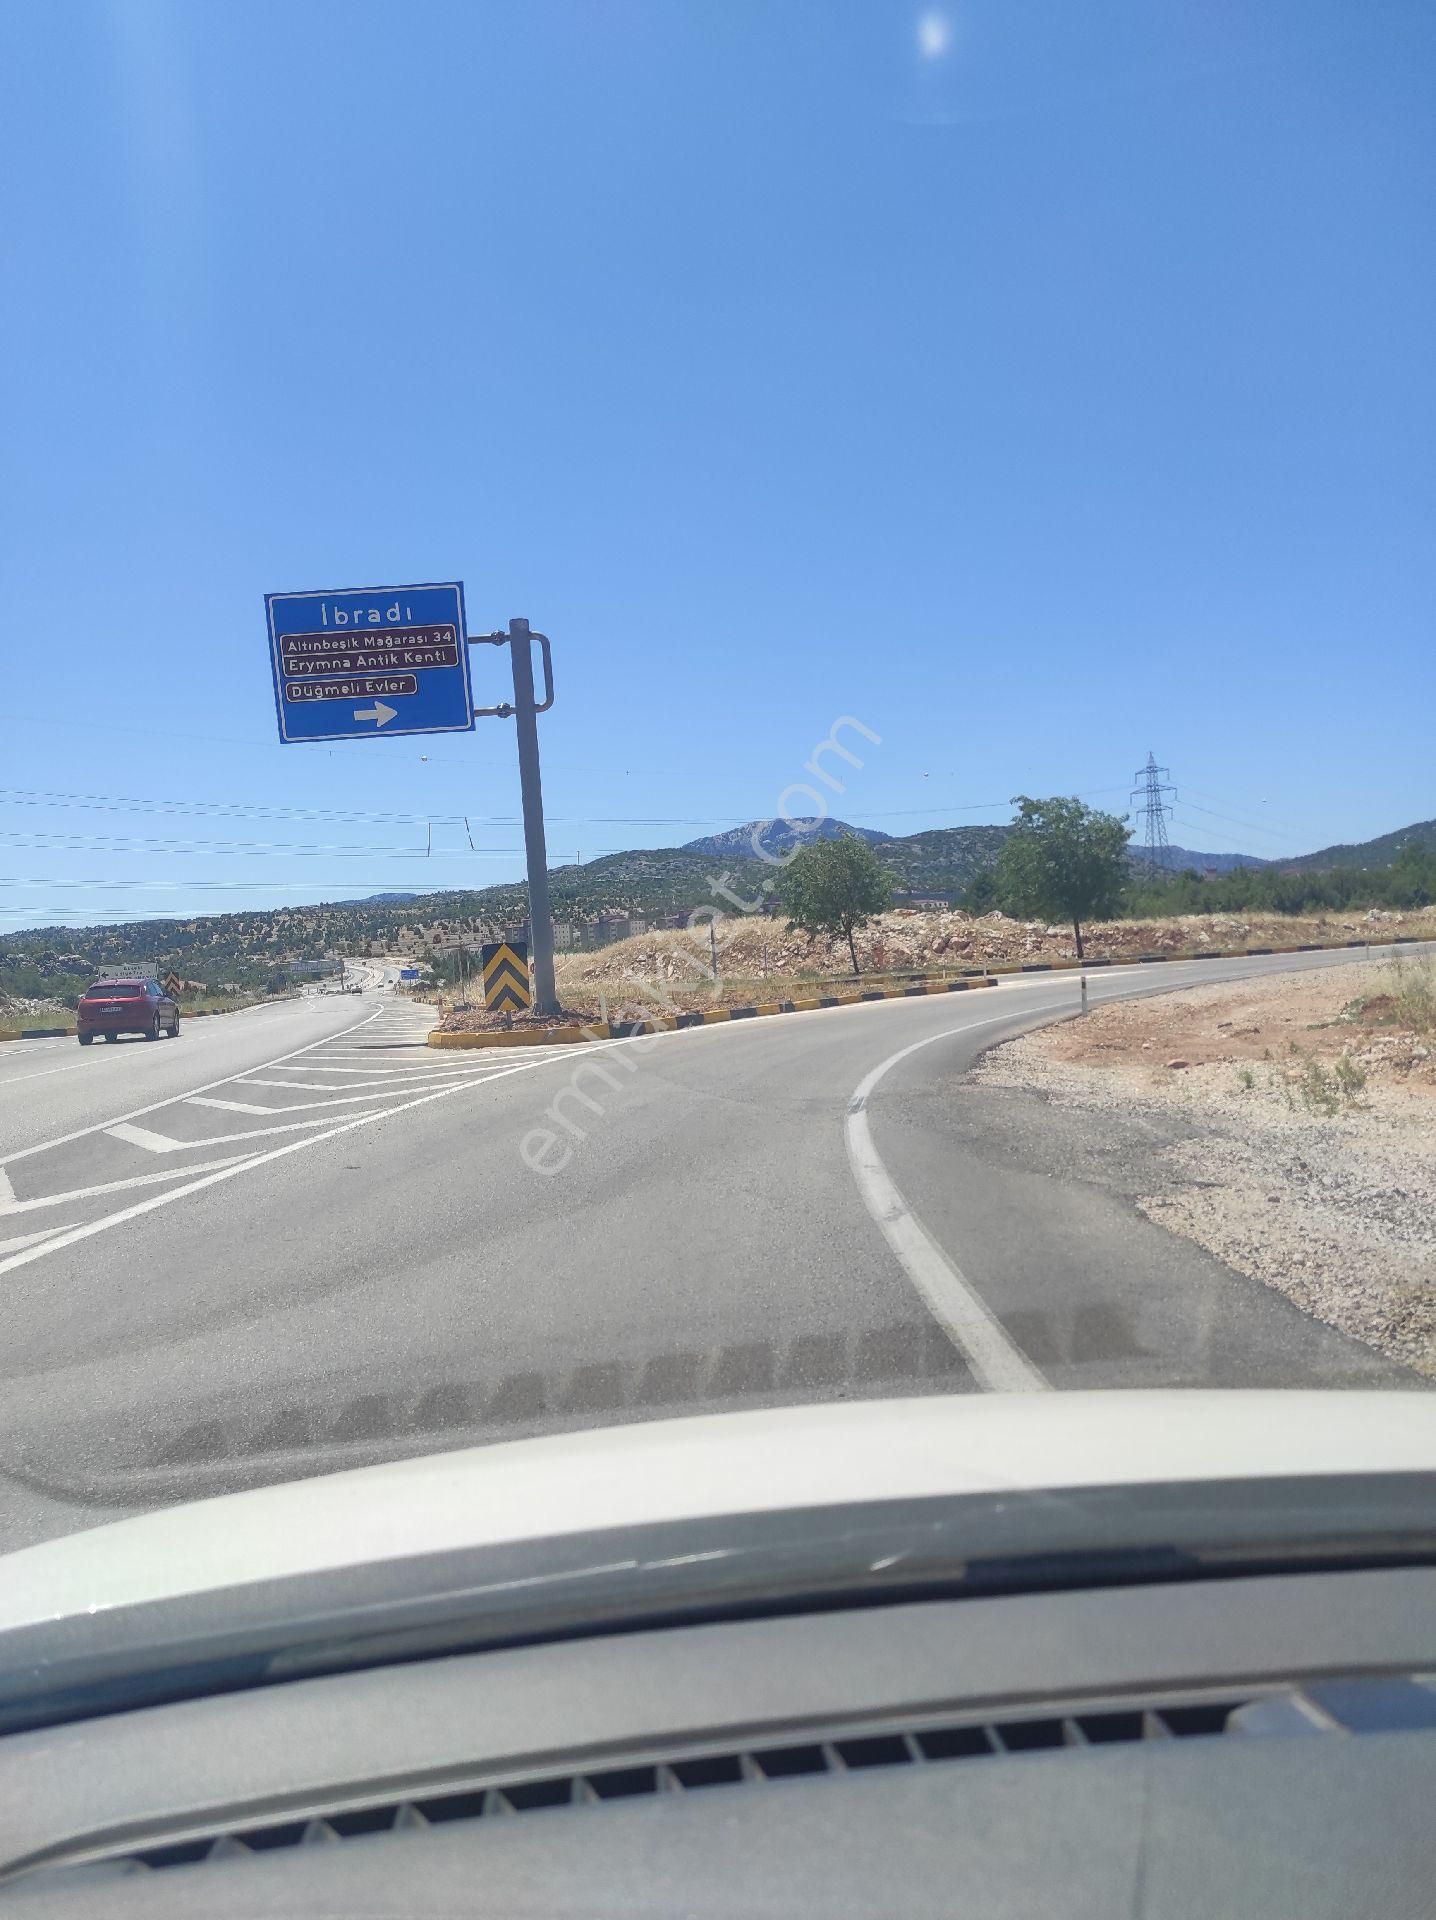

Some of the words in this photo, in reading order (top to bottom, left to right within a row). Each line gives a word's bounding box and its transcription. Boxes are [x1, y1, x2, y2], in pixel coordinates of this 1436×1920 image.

[364, 633, 428, 647] Mağarası
[433, 631, 452, 642] 34
[289, 658, 351, 673] Erymna
[356, 654, 399, 667] Antik
[404, 650, 446, 664] Kenti
[291, 682, 360, 698] Düğmeli
[365, 680, 406, 692] Evler
